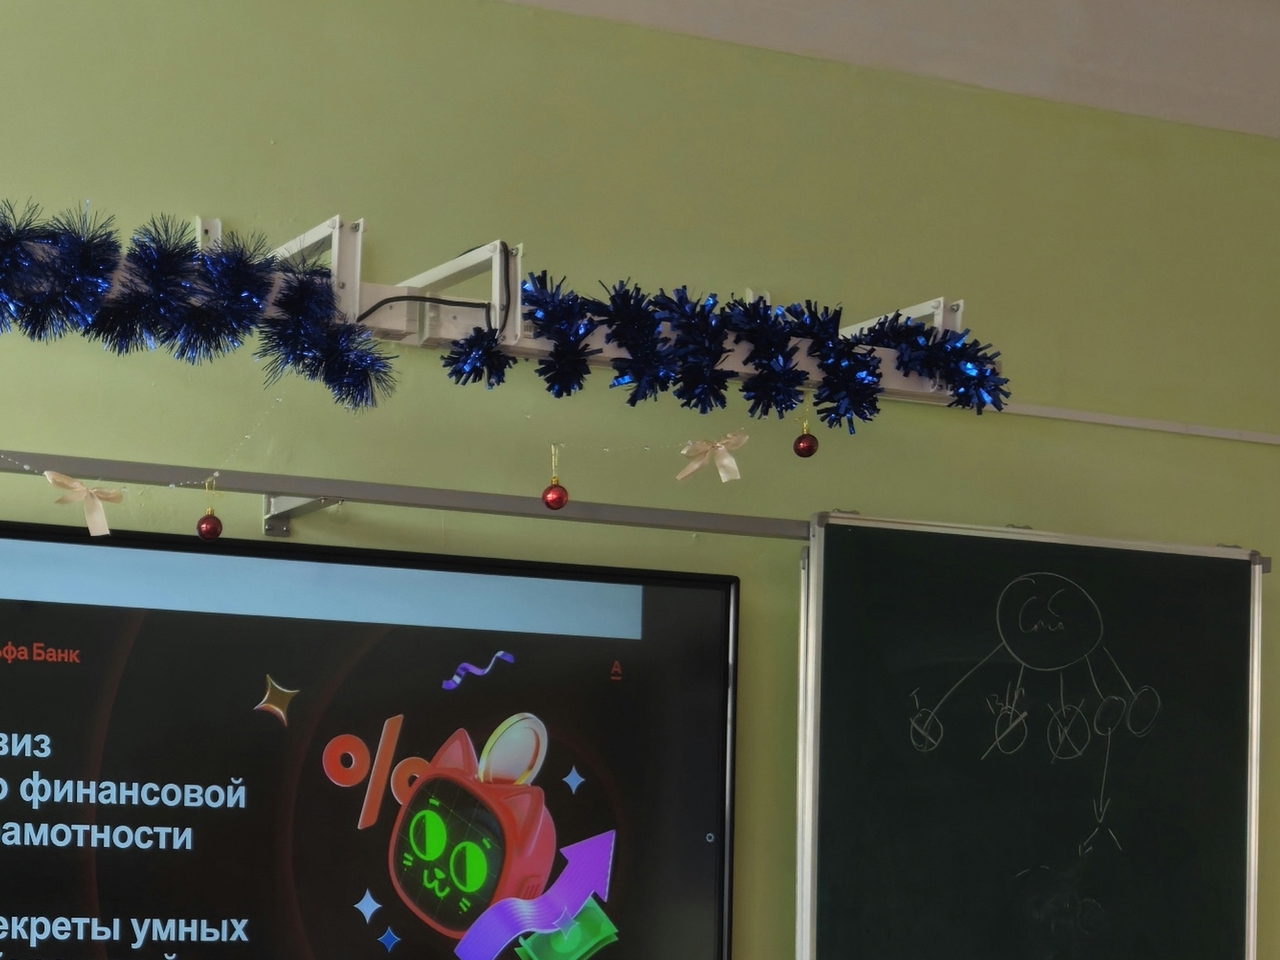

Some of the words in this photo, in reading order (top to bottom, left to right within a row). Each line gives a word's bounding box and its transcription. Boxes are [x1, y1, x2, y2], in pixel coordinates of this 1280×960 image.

[32, 642, 81, 664] Банк
[19, 770, 247, 809] финансовой
[129, 917, 250, 950] умных
